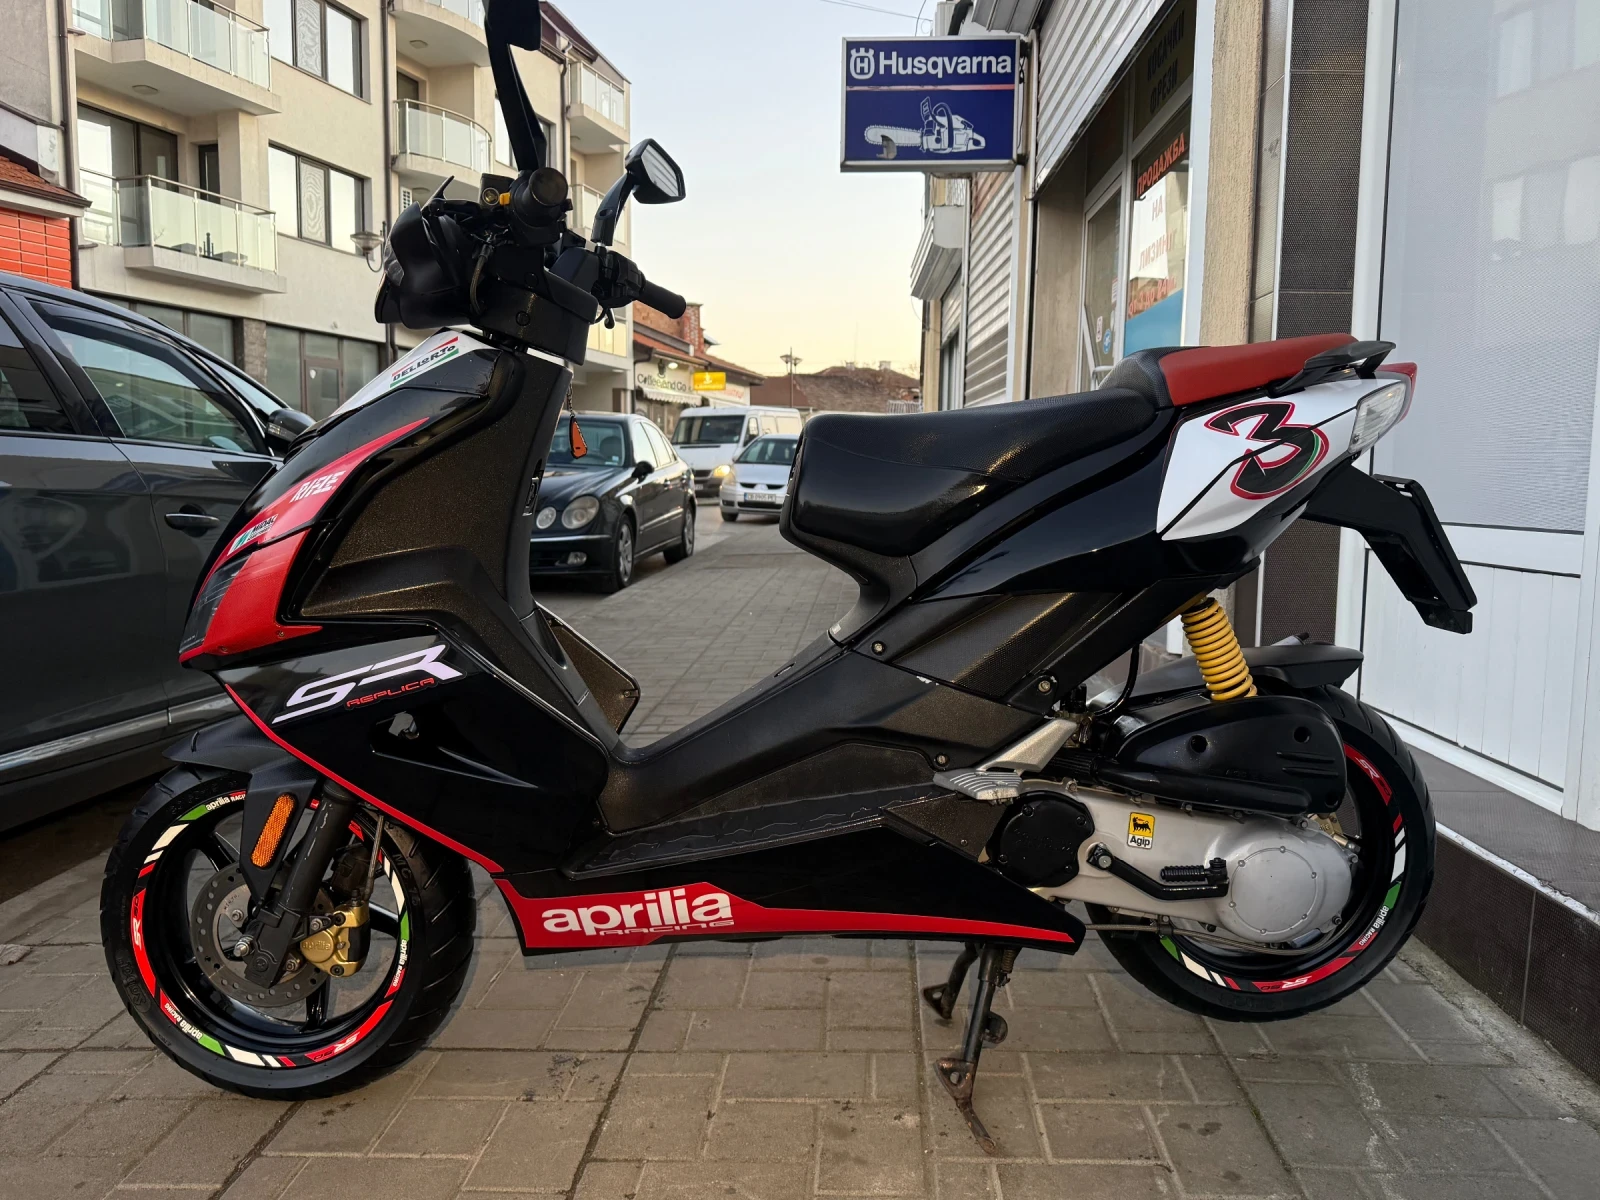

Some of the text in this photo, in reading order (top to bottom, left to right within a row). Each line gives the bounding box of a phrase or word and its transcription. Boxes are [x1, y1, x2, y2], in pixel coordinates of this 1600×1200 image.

[879, 51, 1012, 78] Husqvarna
[1136, 132, 1185, 198] ПРОДАЖБА
[1152, 195, 1164, 222] НА
[1139, 227, 1177, 272] ЛИЗИНГ
[1204, 401, 1329, 500] 3
[271, 644, 463, 725] SR
[346, 677, 435, 707] REPLICA
[205, 796, 230, 811] aprilia
[1130, 835, 1150, 847] Agip
[541, 888, 734, 936] aprilia
[1358, 905, 1391, 946] aprilia RACING
[399, 939, 408, 965] aprilia
[164, 1002, 183, 1023] RACING
[179, 1019, 203, 1041] aprilia
